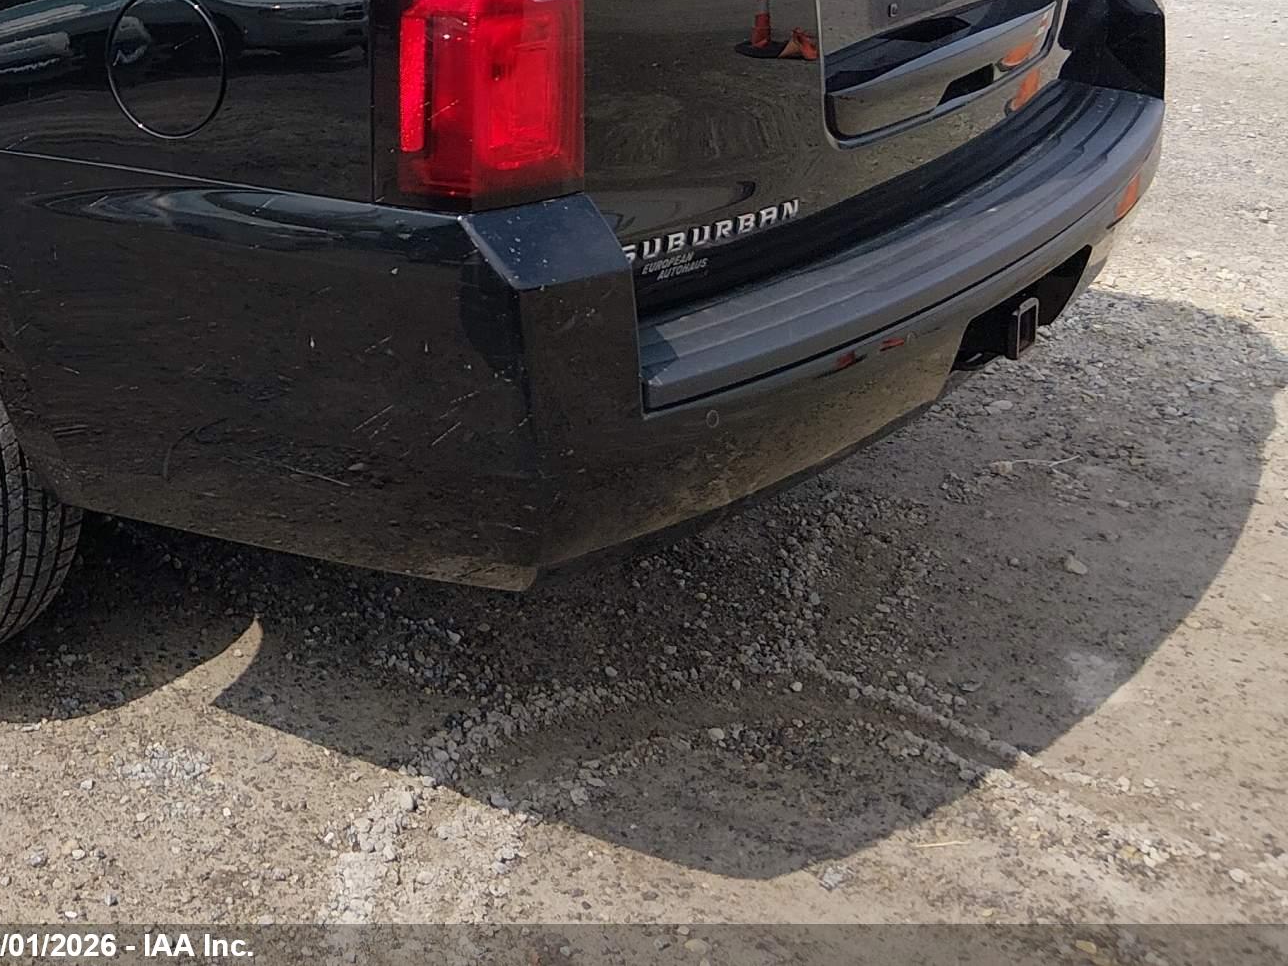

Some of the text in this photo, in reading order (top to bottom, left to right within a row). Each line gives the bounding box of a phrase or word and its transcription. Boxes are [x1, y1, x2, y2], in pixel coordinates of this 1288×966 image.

[622, 199, 800, 264] SUBURBAN
[641, 251, 695, 275] EUROPEAN
[657, 257, 710, 280] AUTOHAUS
